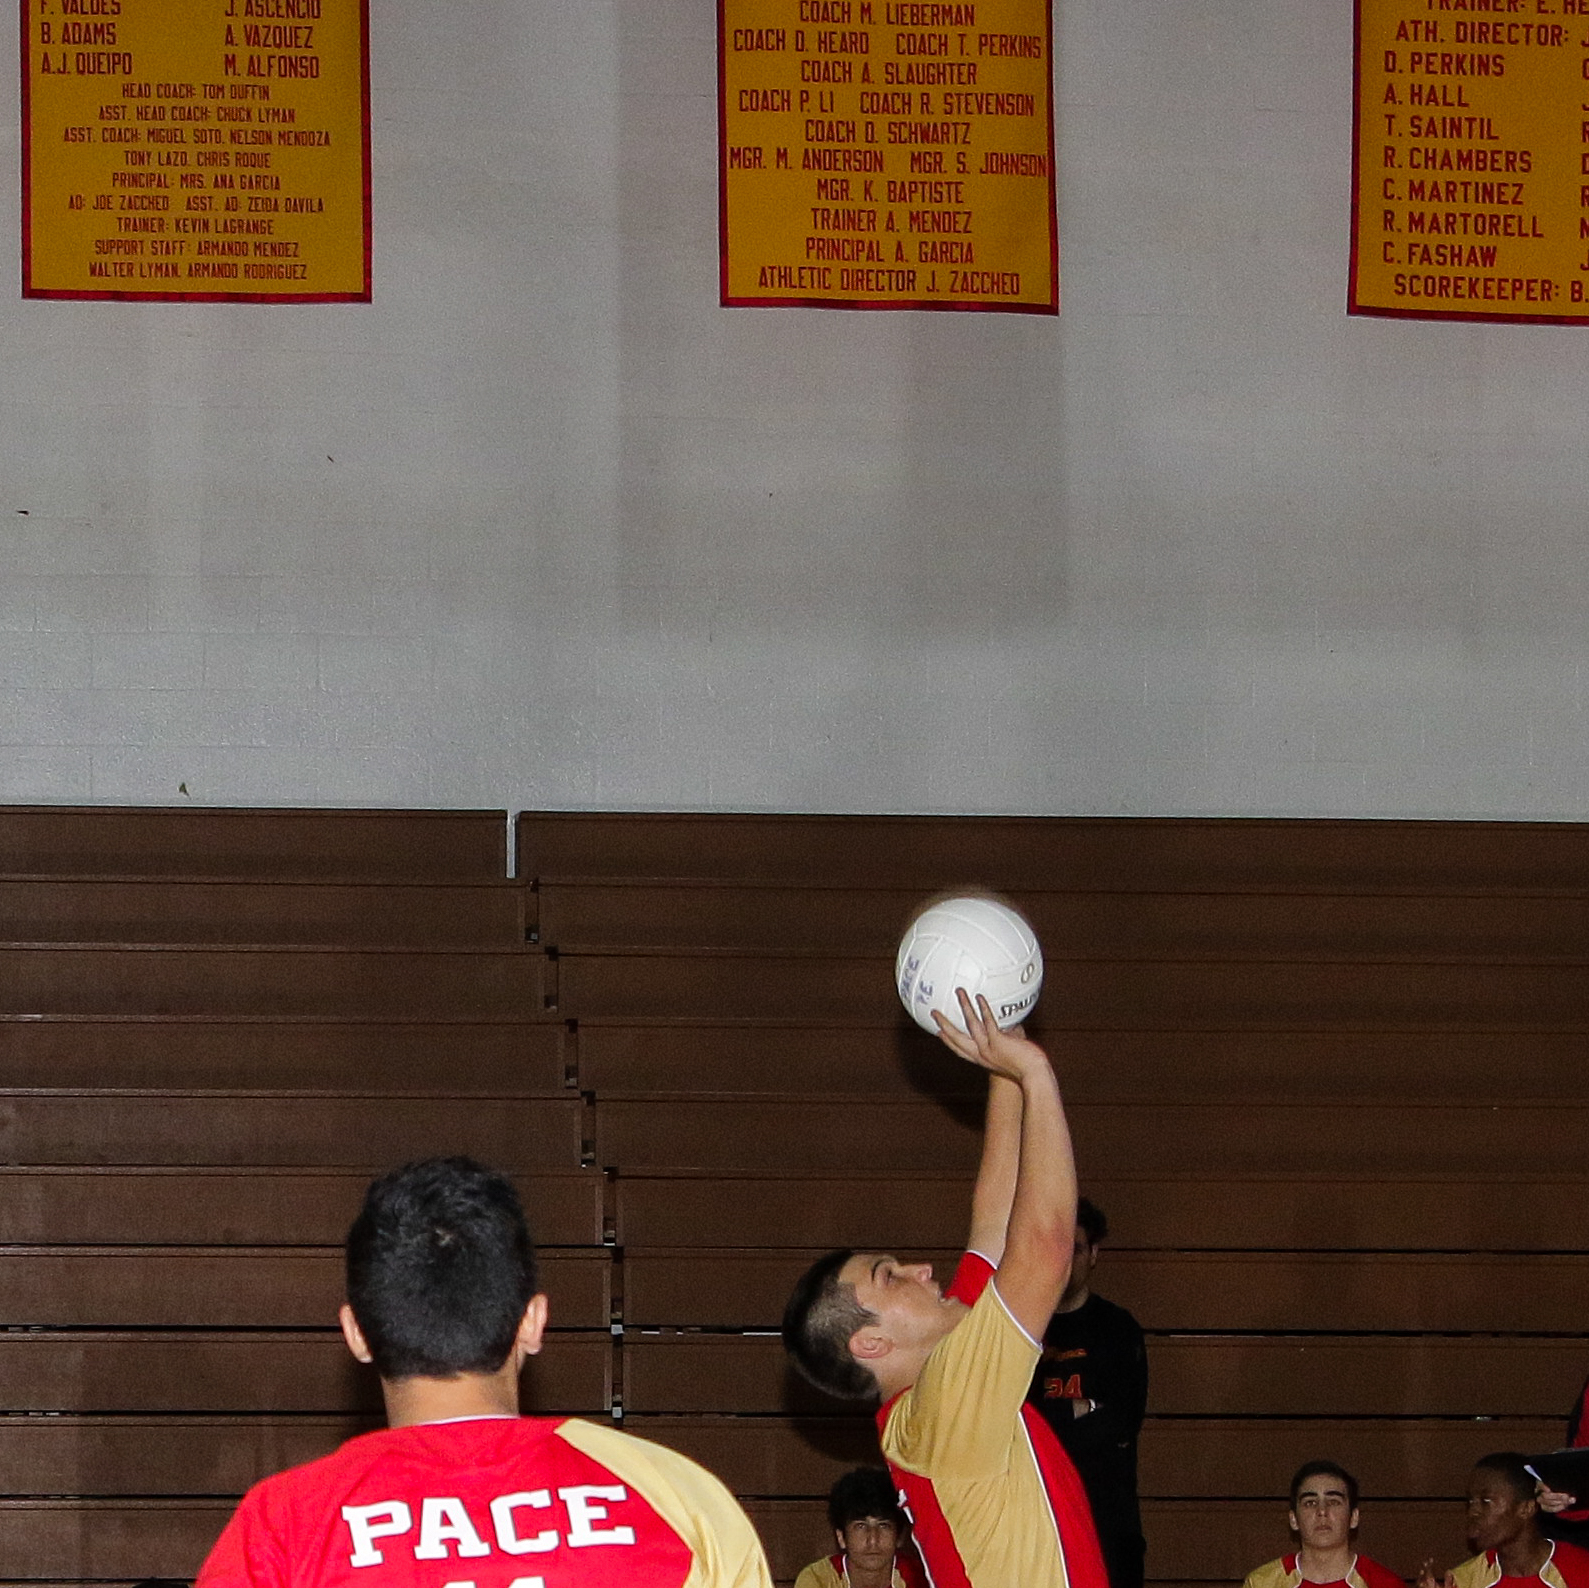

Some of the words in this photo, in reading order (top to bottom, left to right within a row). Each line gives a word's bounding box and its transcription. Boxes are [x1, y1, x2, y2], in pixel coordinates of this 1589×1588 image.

[800, 0, 851, 23] COACH
[887, 3, 974, 26] LIEBERMAN
[41, 22, 54, 44] B.
[62, 22, 116, 45] ADAMS
[225, 25, 238, 46] A.
[244, 25, 313, 49] VAZQUEZ
[734, 29, 785, 51] COACH
[818, 31, 869, 54] HEARD
[42, 52, 70, 74] A.J.
[76, 52, 132, 75] QUEIPO
[225, 54, 240, 76] M.
[247, 55, 319, 78] ALFONSO
[801, 60, 852, 83] COACH
[885, 62, 977, 85] SLAUGHTER
[1385, 51, 1402, 73] D.
[1411, 52, 1504, 76] PERKINS
[1384, 83, 1402, 104] A.
[1410, 84, 1469, 107] HALL
[1385, 114, 1402, 137] T.
[1410, 115, 1499, 140] SAINTIL
[811, 208, 876, 232] TRAINER
[909, 211, 972, 233] MENDEZ
[806, 237, 884, 262] PRINCIPAL
[919, 241, 973, 264] GARCIA
[1383, 241, 1401, 263] C.
[1408, 243, 1497, 267] FASHAW
[759, 266, 831, 290] ATHLETIC
[841, 269, 916, 291] DIRECTOR
[950, 271, 1020, 295] ZACCHEO
[1571, 281, 1588, 302] B.
[341, 1485, 636, 1568] PACE
